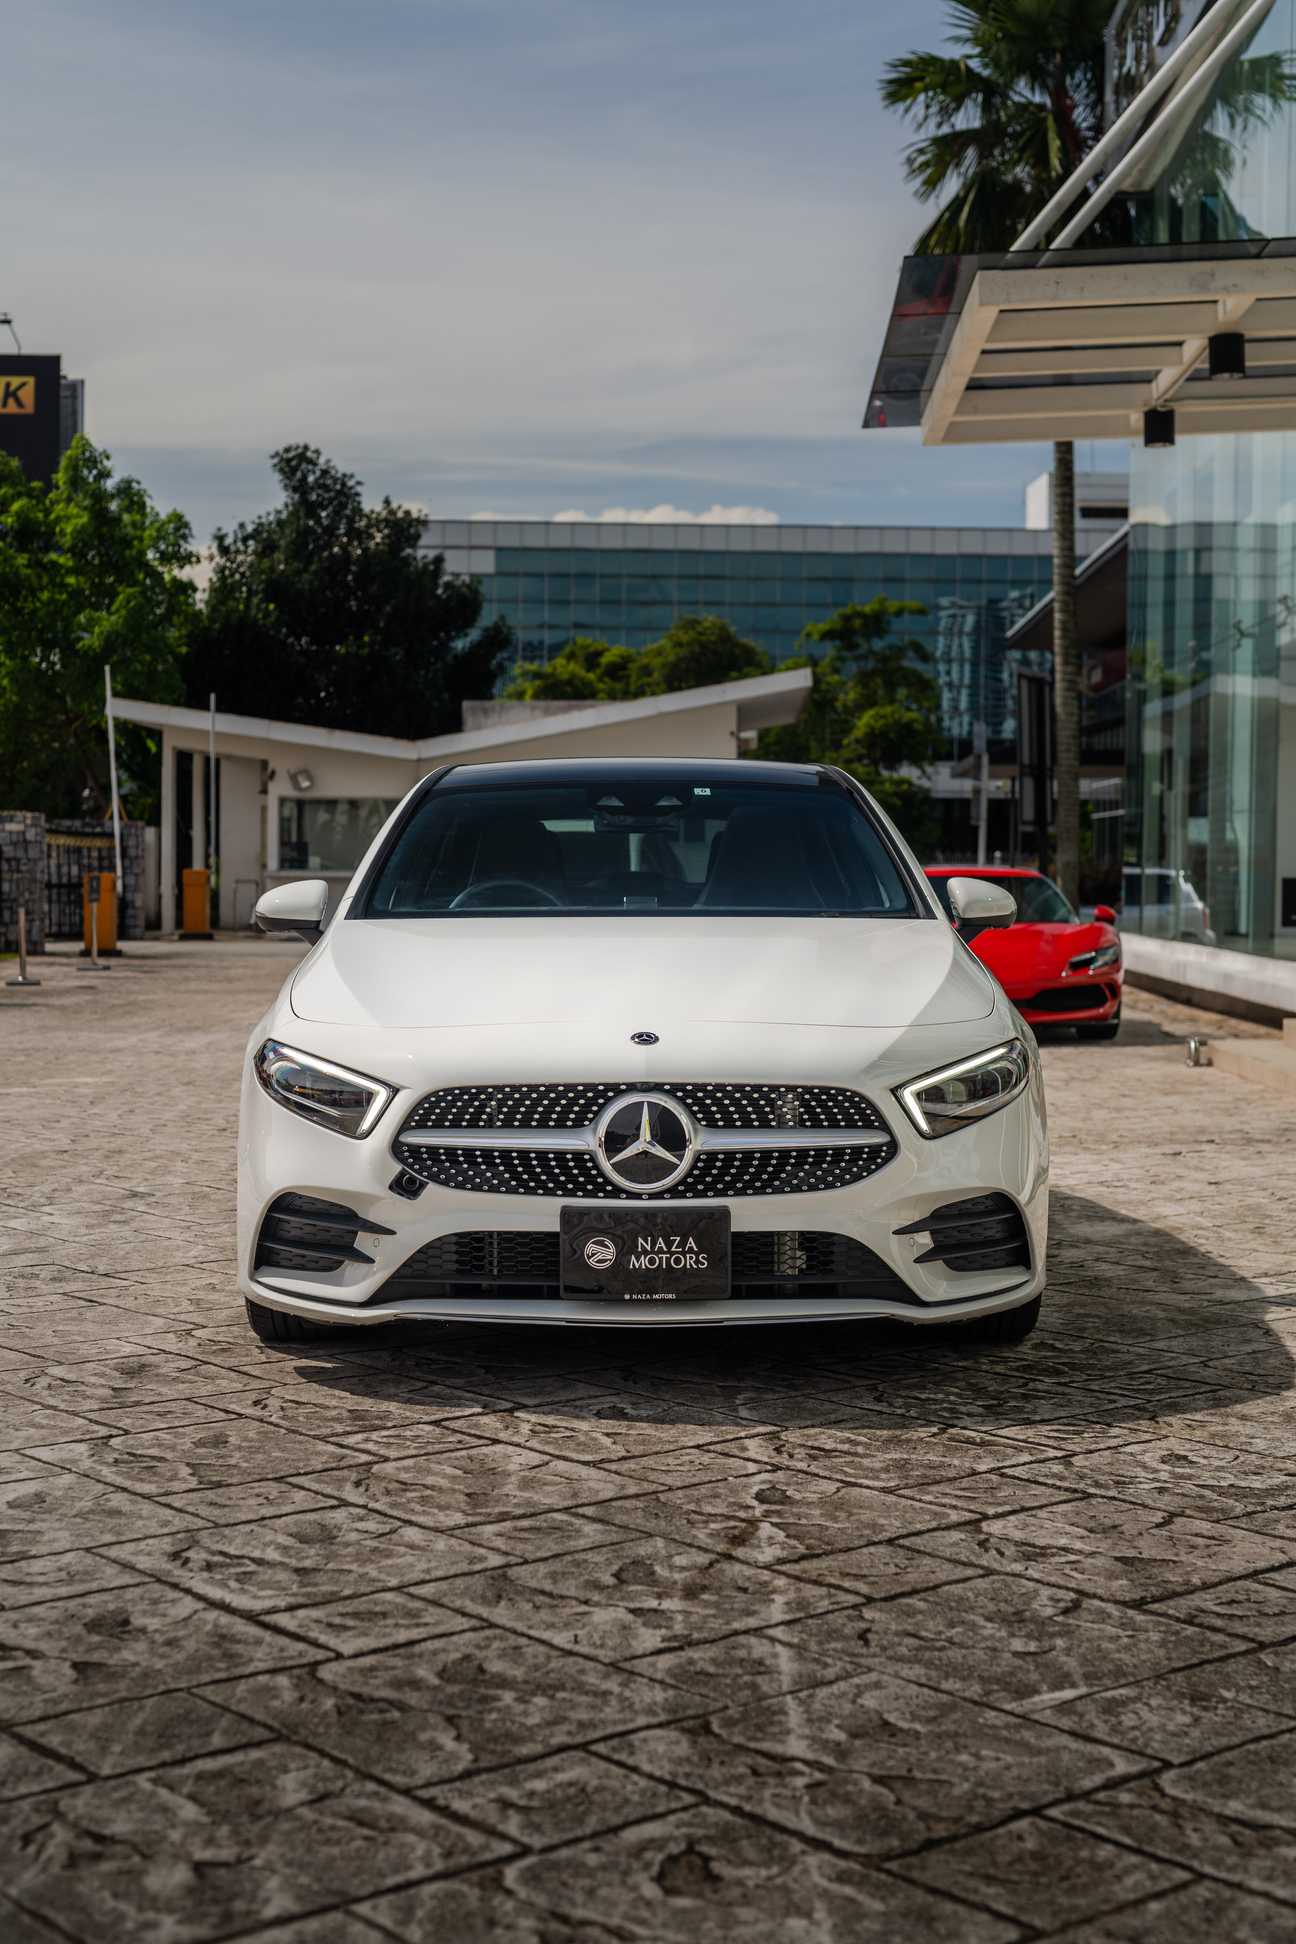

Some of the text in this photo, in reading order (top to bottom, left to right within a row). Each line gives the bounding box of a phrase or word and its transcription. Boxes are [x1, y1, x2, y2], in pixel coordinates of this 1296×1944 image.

[1, 381, 28, 409] K
[637, 1236, 698, 1251] NAZA
[629, 1254, 708, 1269] MOTORS
